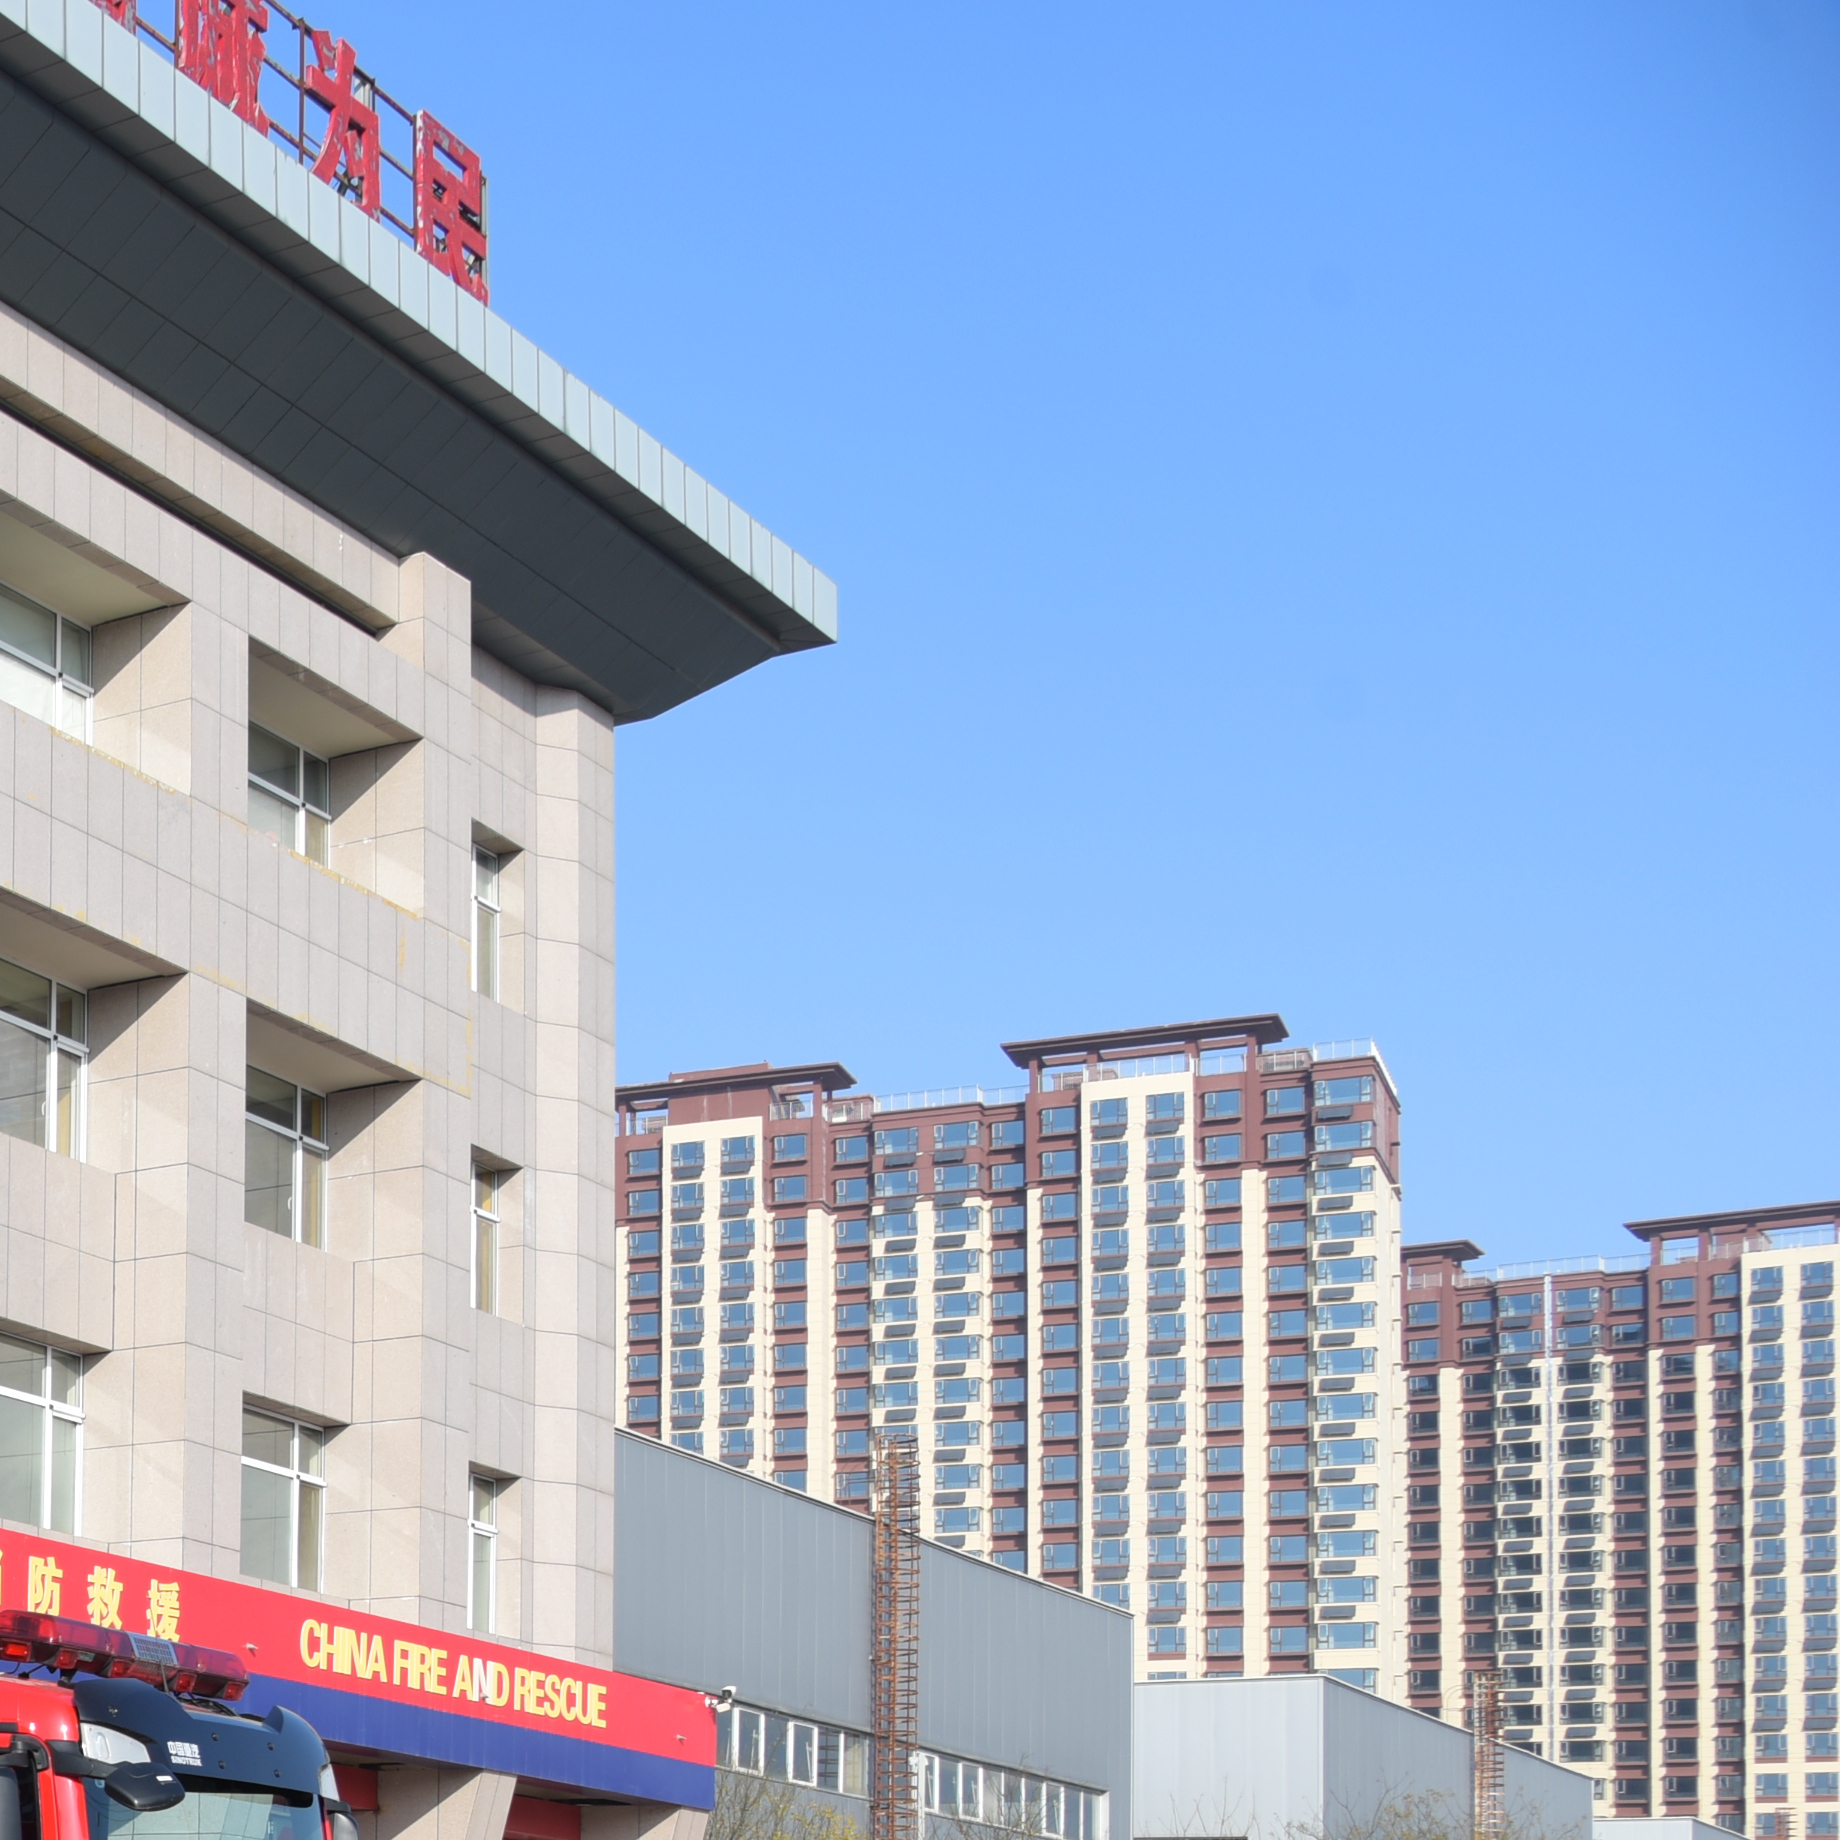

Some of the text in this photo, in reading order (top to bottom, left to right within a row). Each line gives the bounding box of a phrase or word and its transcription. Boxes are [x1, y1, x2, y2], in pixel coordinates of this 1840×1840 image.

[301, 1618, 608, 1730] CHINA FIRE AND RESCUE
